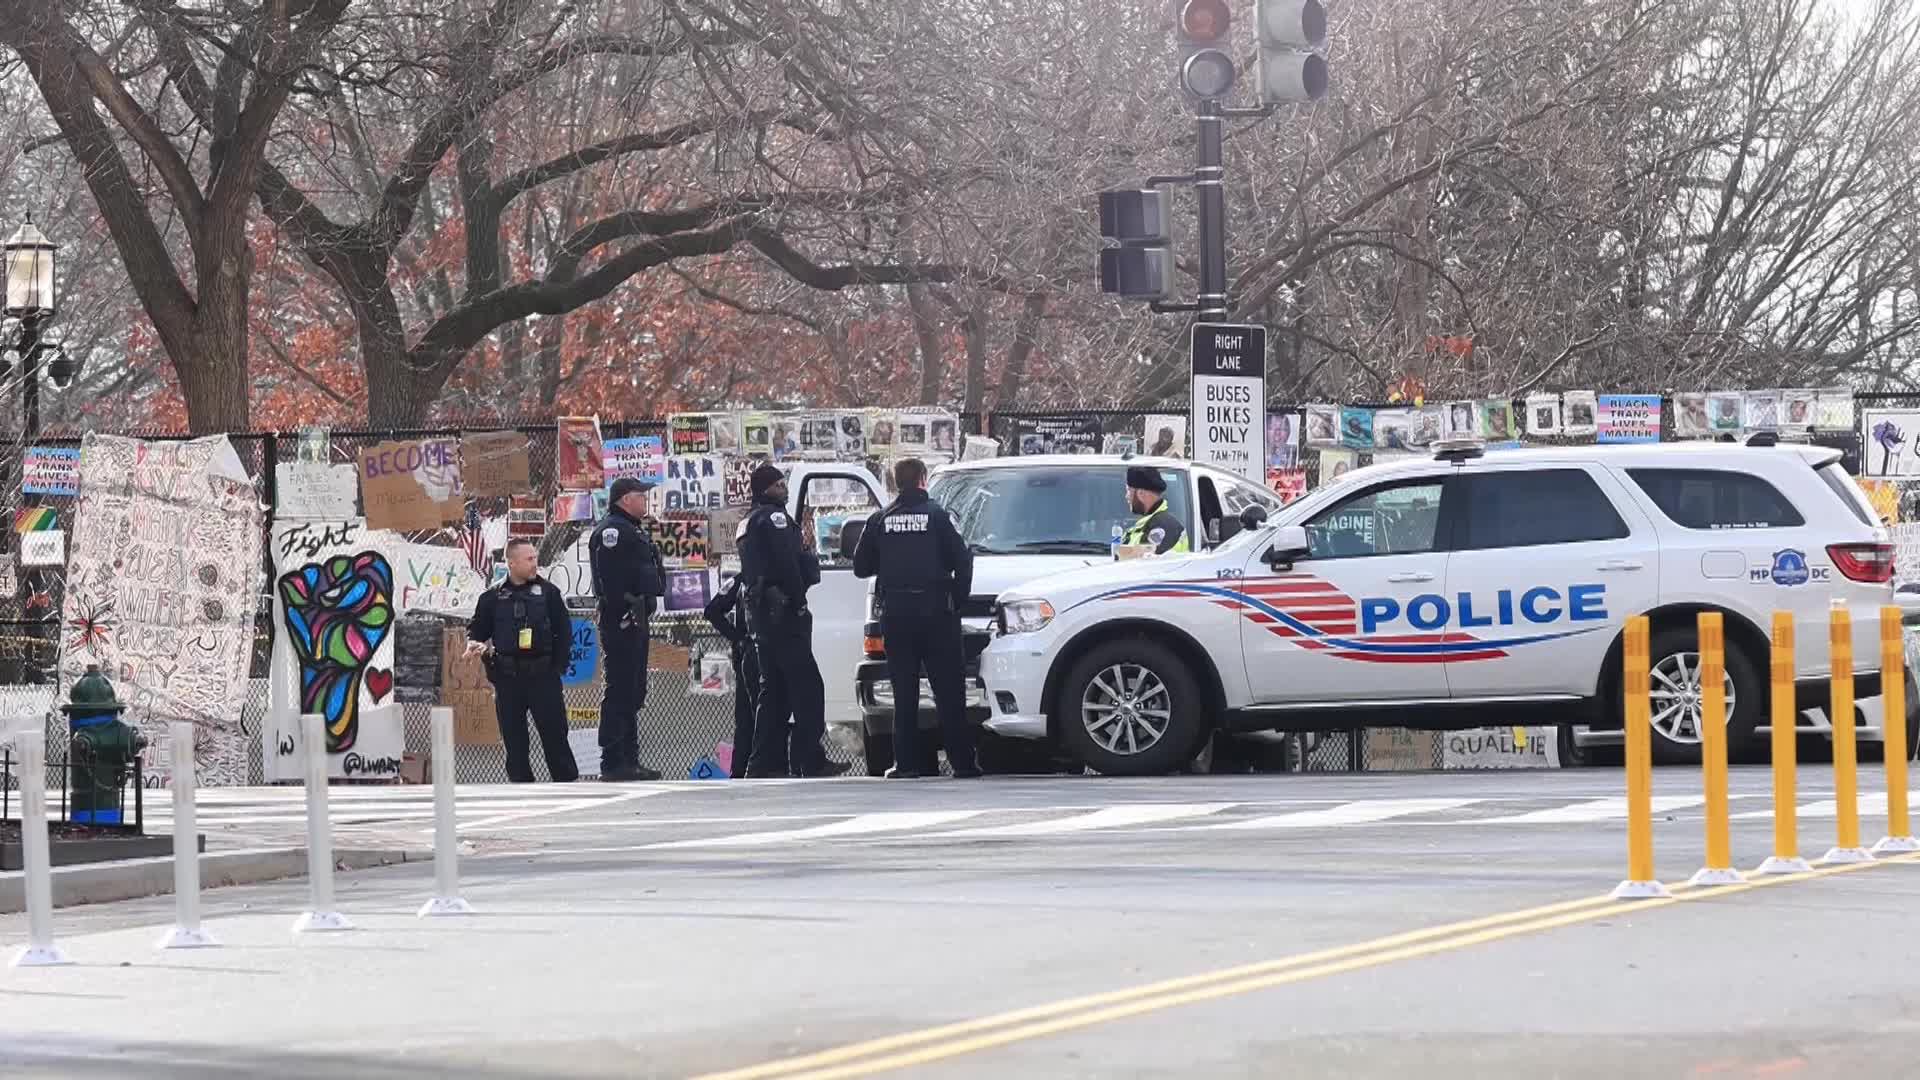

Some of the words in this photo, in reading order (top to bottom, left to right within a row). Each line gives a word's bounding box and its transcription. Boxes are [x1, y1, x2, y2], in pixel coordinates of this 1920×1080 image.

[1215, 334, 1243, 350] RIGHT
[1216, 356, 1241, 370] LANE
[1207, 384, 1250, 403] BUSES
[1610, 400, 1649, 408] BLACK
[1207, 406, 1250, 424] BIKES
[1611, 410, 1649, 418] TRANS
[1612, 420, 1646, 428] LIVES
[1209, 426, 1248, 443] ONLY
[614, 442, 651, 452] BLACK
[36, 453, 73, 461] BLACK
[615, 452, 652, 462] TRANS
[1209, 450, 1249, 462] 7AM-7PM
[617, 462, 649, 471] LIVES
[37, 472, 69, 480] LIVES
[30, 481, 75, 489] MATTER
[885, 522, 928, 533] POLICE
[279, 521, 359, 560] Fight
[1216, 568, 1242, 577] 120
[1750, 569, 1769, 580] MP
[1811, 568, 1830, 579] DC
[1361, 584, 1607, 633] POLICE
